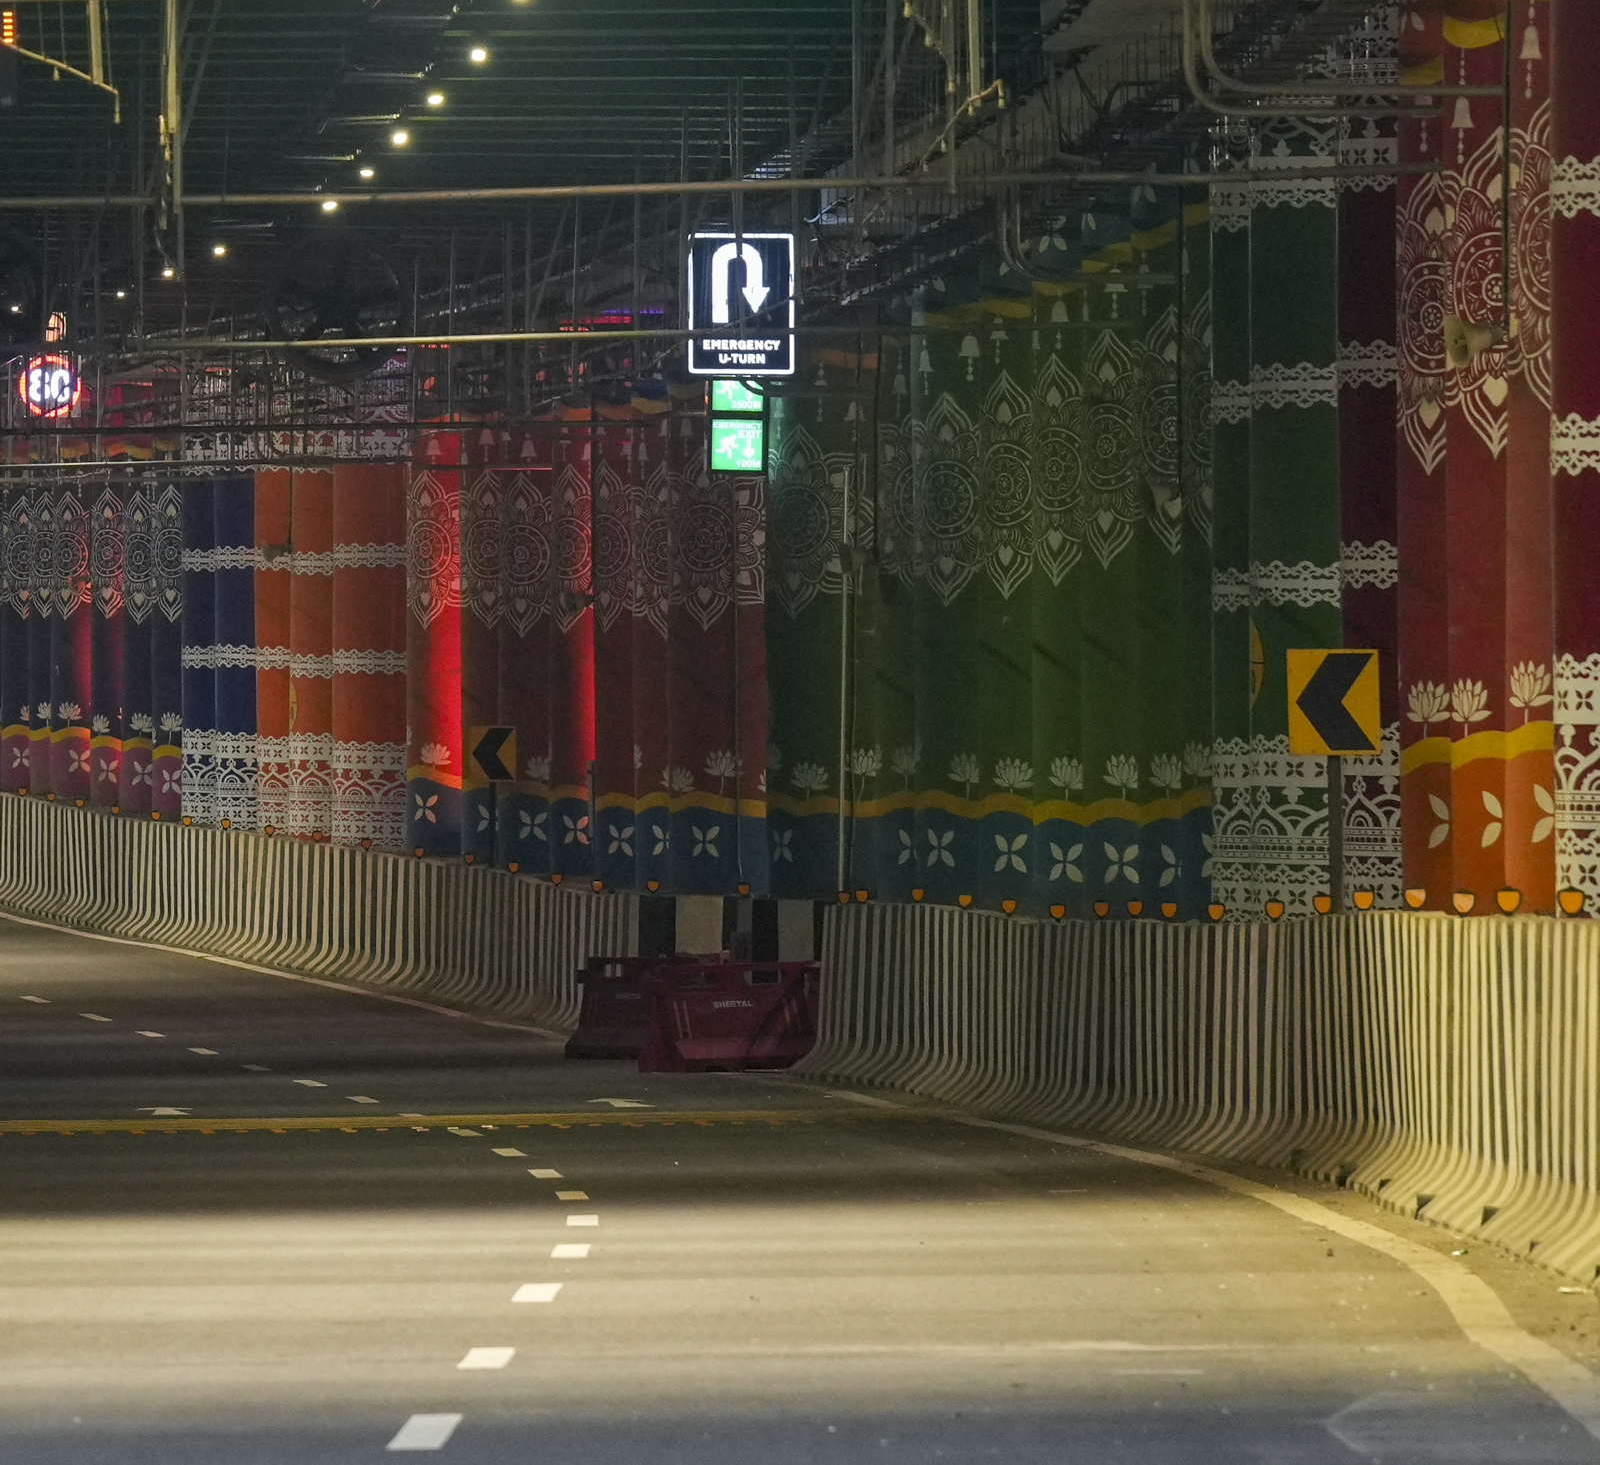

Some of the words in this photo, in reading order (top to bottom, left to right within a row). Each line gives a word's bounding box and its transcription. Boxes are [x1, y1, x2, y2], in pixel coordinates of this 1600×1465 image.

[702, 339, 781, 351] EMERGENCY
[718, 353, 766, 365] U-TURN
[731, 399, 762, 410] 3500M
[712, 421, 762, 431] EMERGENCY
[738, 429, 762, 439] EXIT
[736, 458, 762, 469] 100M
[713, 1000, 753, 1009] SHEETAL
